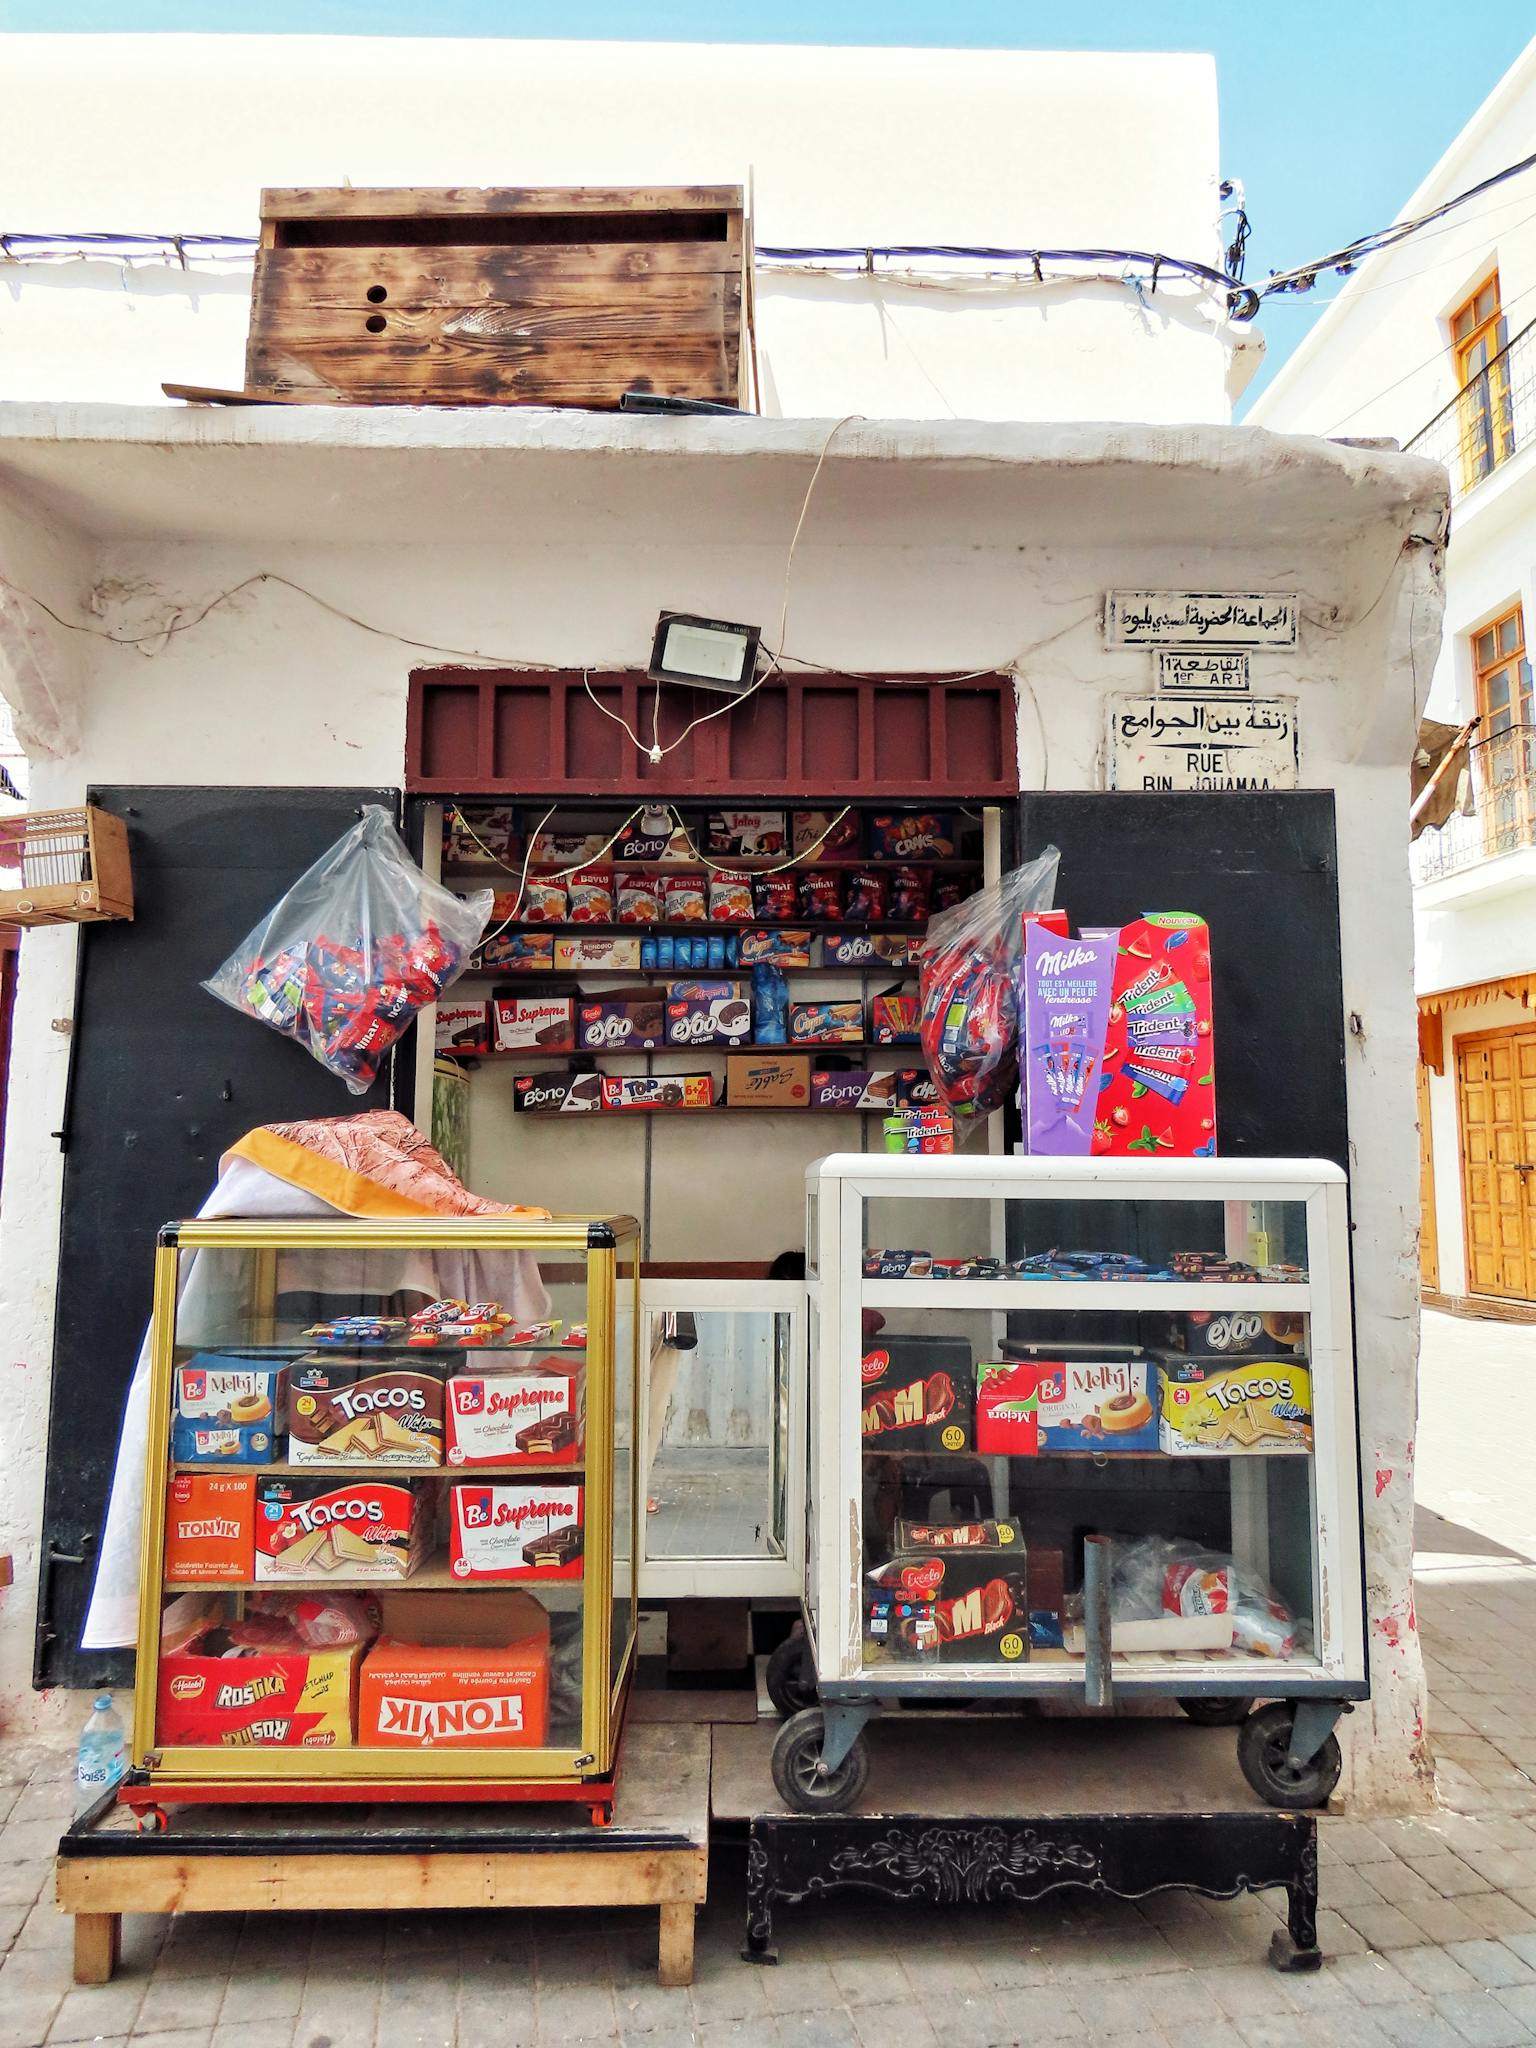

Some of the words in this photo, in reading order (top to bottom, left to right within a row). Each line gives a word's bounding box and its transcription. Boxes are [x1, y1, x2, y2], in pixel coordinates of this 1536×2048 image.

[1189, 605, 1238, 635] الحضرية
[1237, 606, 1287, 631] الجماعة
[1120, 705, 1205, 737] الجوامع
[1207, 715, 1240, 736] بين
[1245, 708, 1288, 740] زنقة
[1187, 753, 1223, 773] RUE
[623, 840, 665, 858] Bono
[895, 834, 933, 856] CRAKS
[1158, 916, 1198, 925] Nouveau
[1036, 947, 1098, 976] Milka
[1038, 988, 1057, 996] AVEC
[1072, 988, 1086, 996] PEU
[1088, 988, 1098, 996] DE
[1055, 980, 1066, 988] EST
[1067, 980, 1097, 988] MEILLEUR
[1121, 969, 1159, 1002] Trident
[1134, 991, 1174, 1014] Trident
[519, 1006, 566, 1026] Supreme
[1050, 1014, 1080, 1028] Milka
[1133, 1018, 1180, 1033] Trident
[624, 1079, 658, 1097] TOP
[820, 1086, 863, 1103] Bono
[524, 1088, 566, 1107] Bono
[908, 1125, 941, 1137] Trident
[881, 1264, 907, 1274] Bono
[862, 1361, 885, 1374] celo
[487, 1388, 565, 1417] Supreme
[1177, 1390, 1187, 1398] 24
[988, 1409, 1030, 1423] Mejora
[946, 1430, 961, 1441] 60
[209, 1482, 218, 1490] 24
[234, 1482, 247, 1490] 100
[494, 1500, 573, 1530] Supreme
[180, 1522, 239, 1537] TONIK
[1004, 1641, 1018, 1650] 60
[384, 1700, 517, 1733] TONIK
